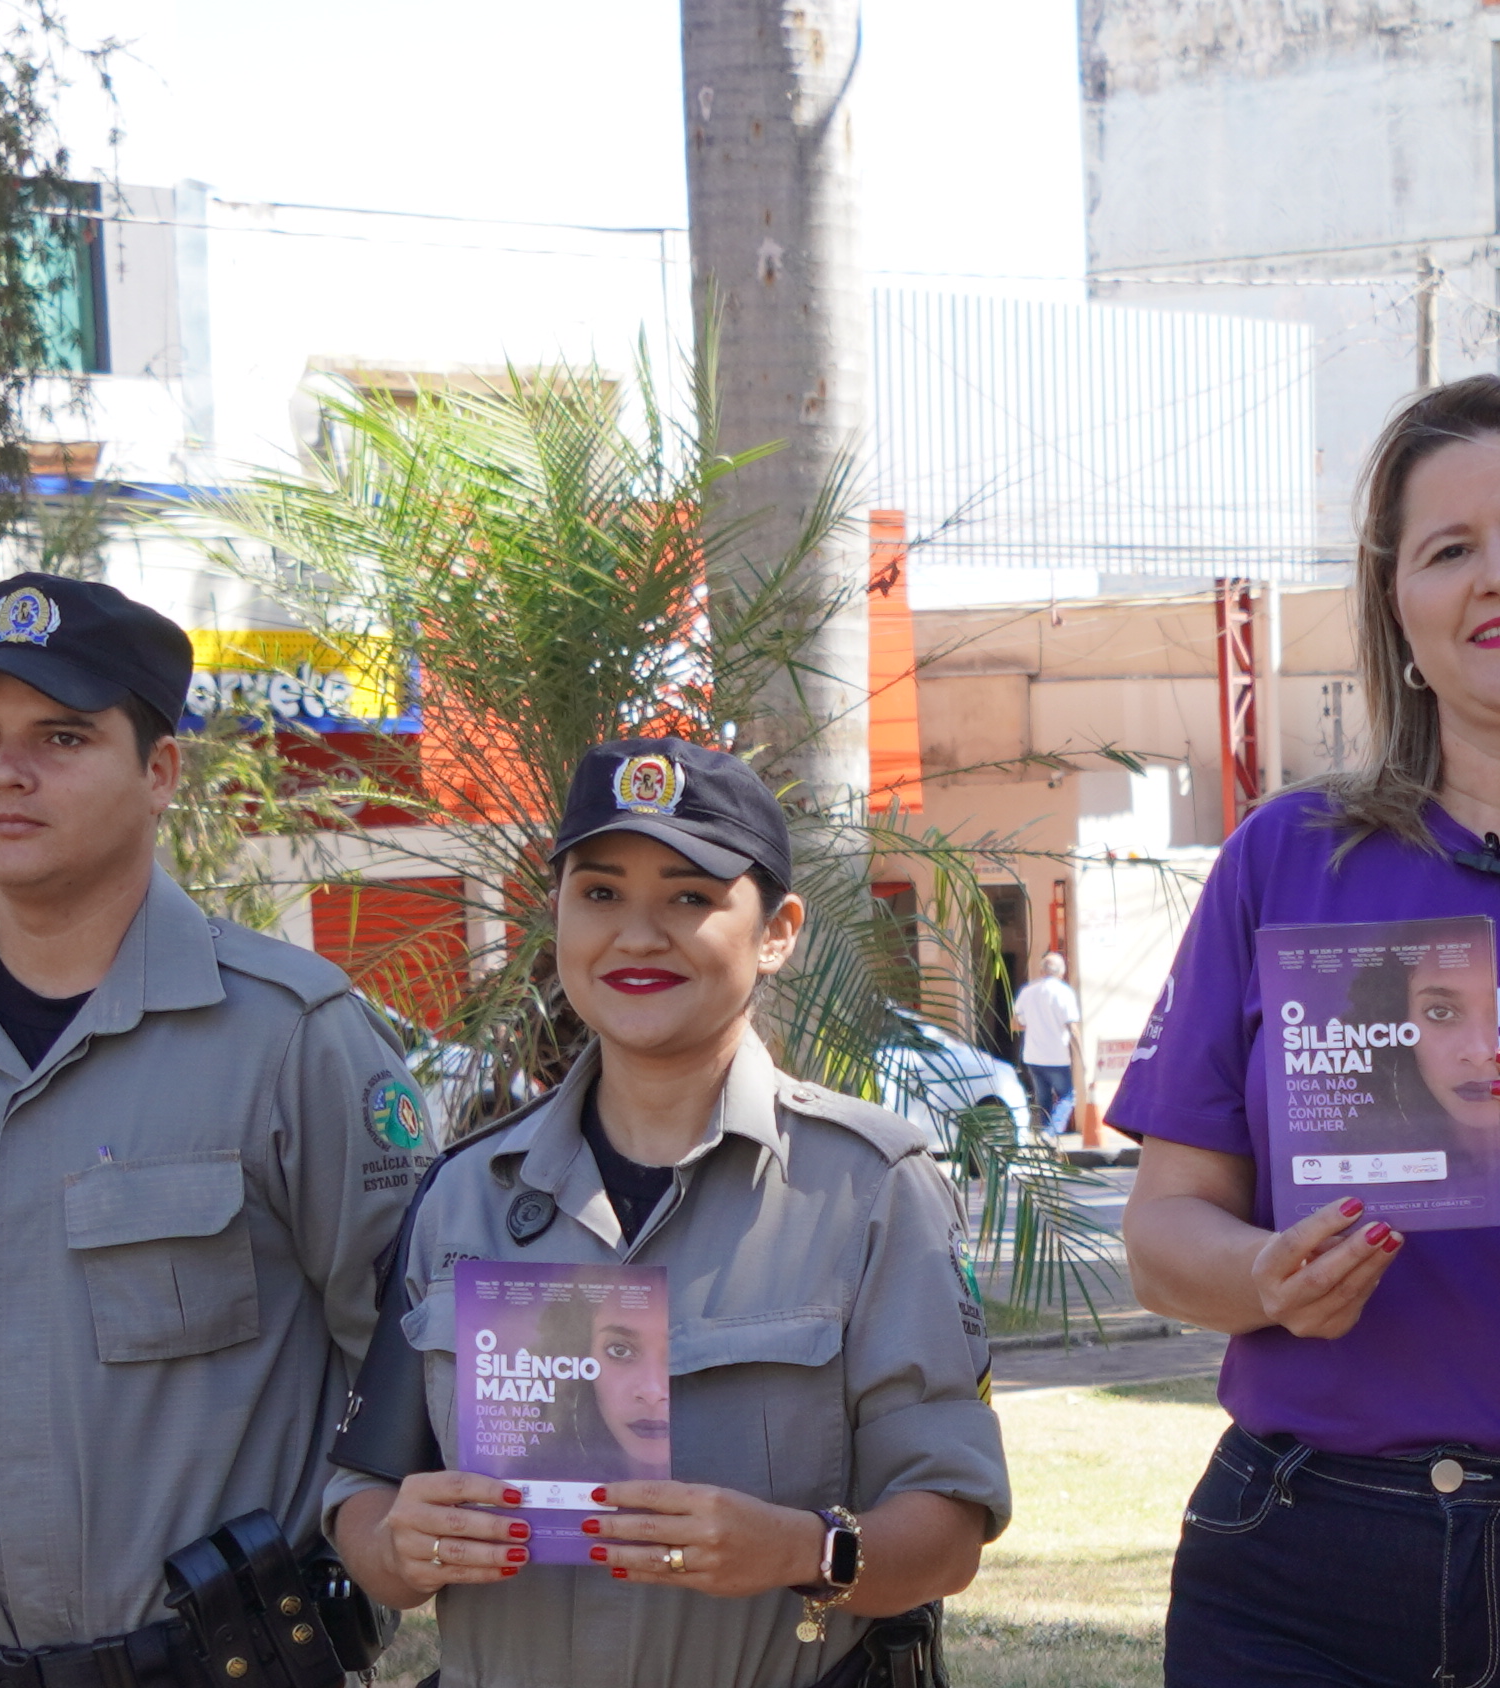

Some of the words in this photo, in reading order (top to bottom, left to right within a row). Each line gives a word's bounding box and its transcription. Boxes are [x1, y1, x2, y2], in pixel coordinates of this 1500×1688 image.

[1281, 1001, 1304, 1025] O
[1282, 1018, 1421, 1050] SILÊNCIO
[1285, 1049, 1373, 1075] MATA!
[1286, 1080, 1320, 1091] DIGA
[1326, 1076, 1357, 1090] NÃO
[1288, 1092, 1297, 1106] À
[1303, 1091, 1374, 1106] VIOLÊNCIA
[1288, 1107, 1342, 1119] CONTRA
[1348, 1106, 1358, 1118] A
[1289, 1120, 1347, 1132] MULHER.
[361, 1154, 411, 1175] POLÍCIA
[363, 1172, 410, 1193] ESTADO
[476, 1329, 497, 1352] O
[476, 1348, 601, 1380] SILÊNCIO
[476, 1377, 555, 1403] MATA!
[476, 1405, 507, 1416] DIGA
[512, 1403, 541, 1418] NÃO
[476, 1416, 485, 1430] À
[490, 1418, 555, 1433] VIOLÊNCIA
[476, 1432, 525, 1444] CONTRA
[530, 1434, 541, 1445] A
[476, 1444, 529, 1457] MULHER.
